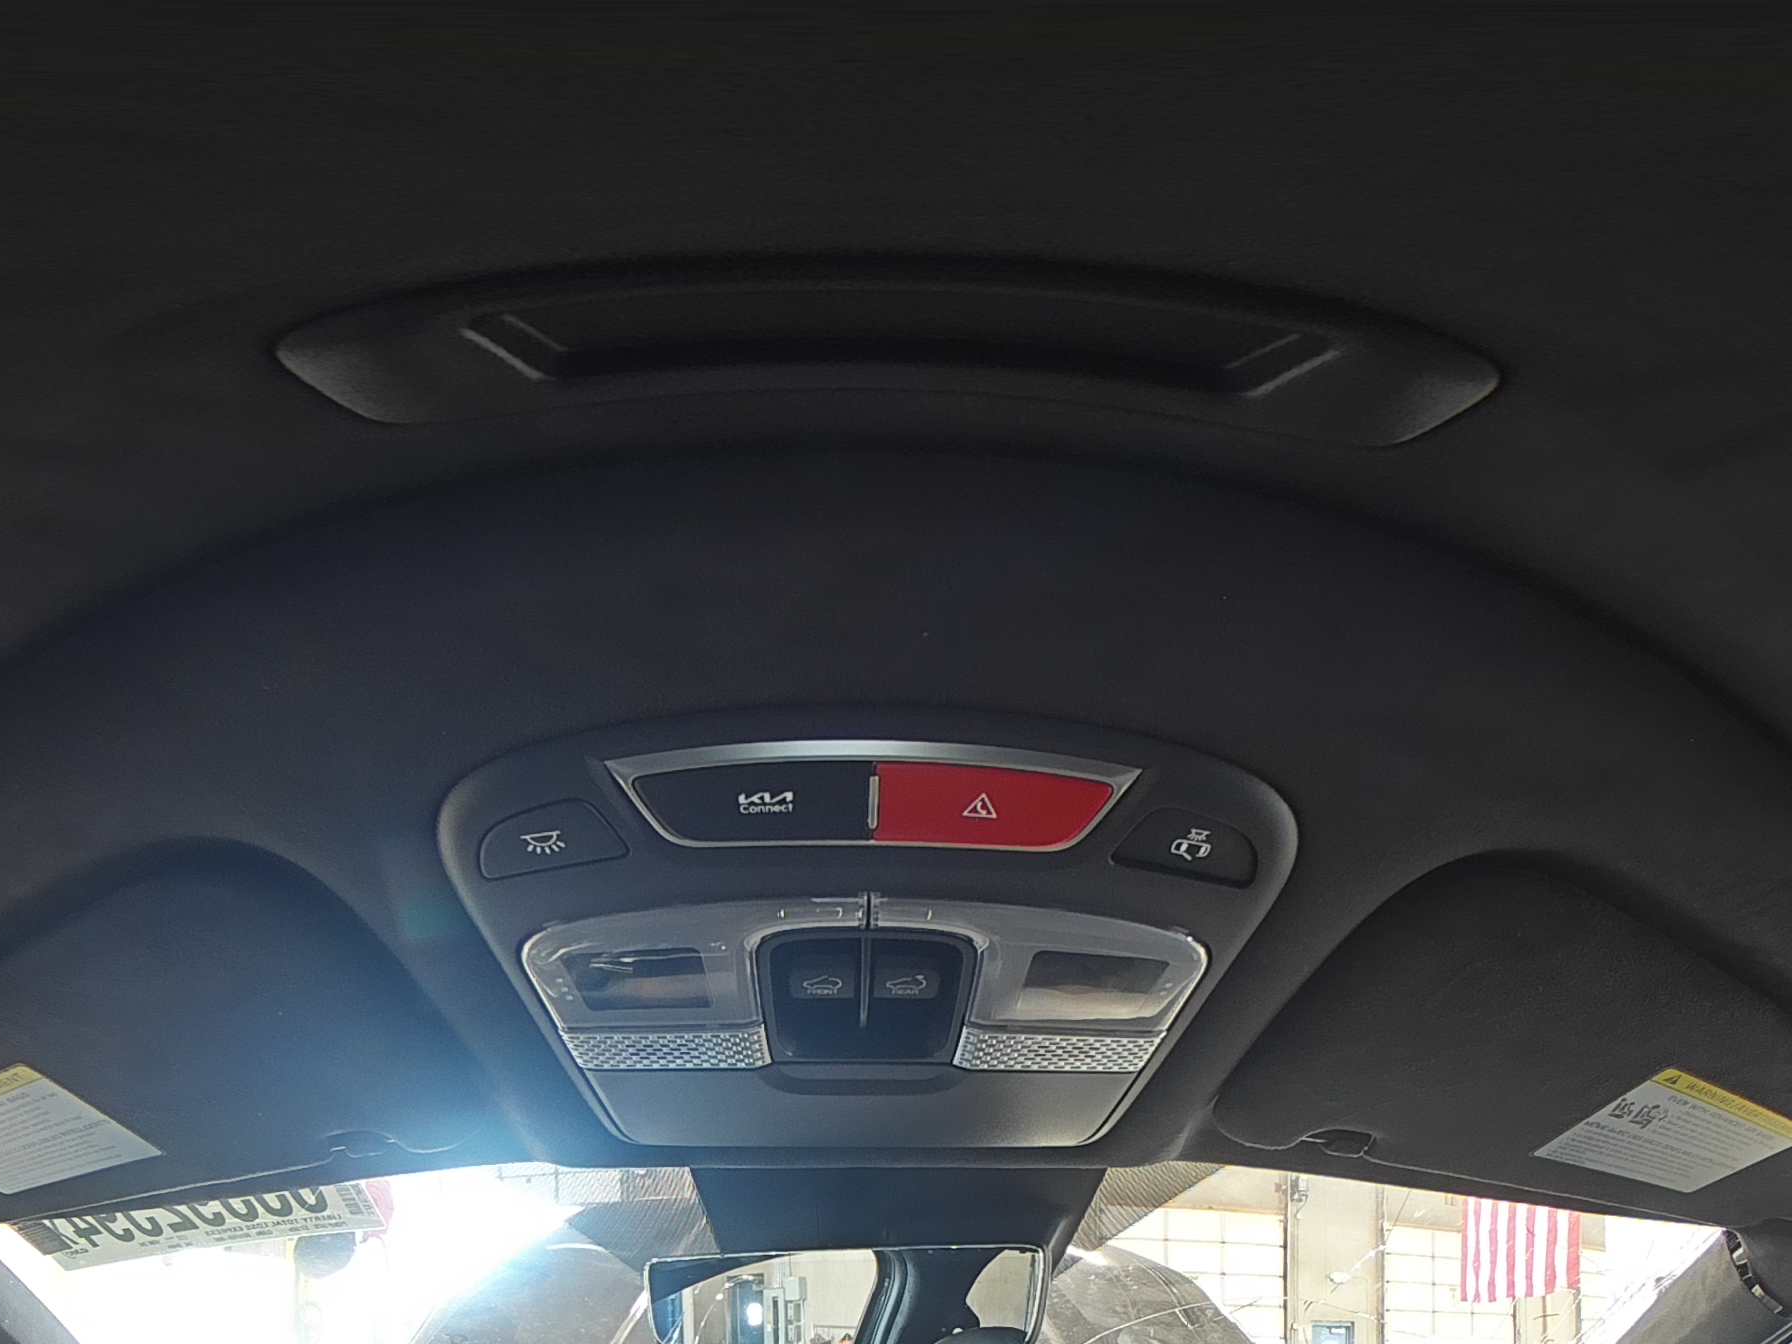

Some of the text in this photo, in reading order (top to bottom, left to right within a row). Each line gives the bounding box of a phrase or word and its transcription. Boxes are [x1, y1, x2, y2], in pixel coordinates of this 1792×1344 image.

[738, 791, 794, 804] KIA
[740, 803, 793, 813] Connect
[1681, 1082, 1737, 1106] WARNING
